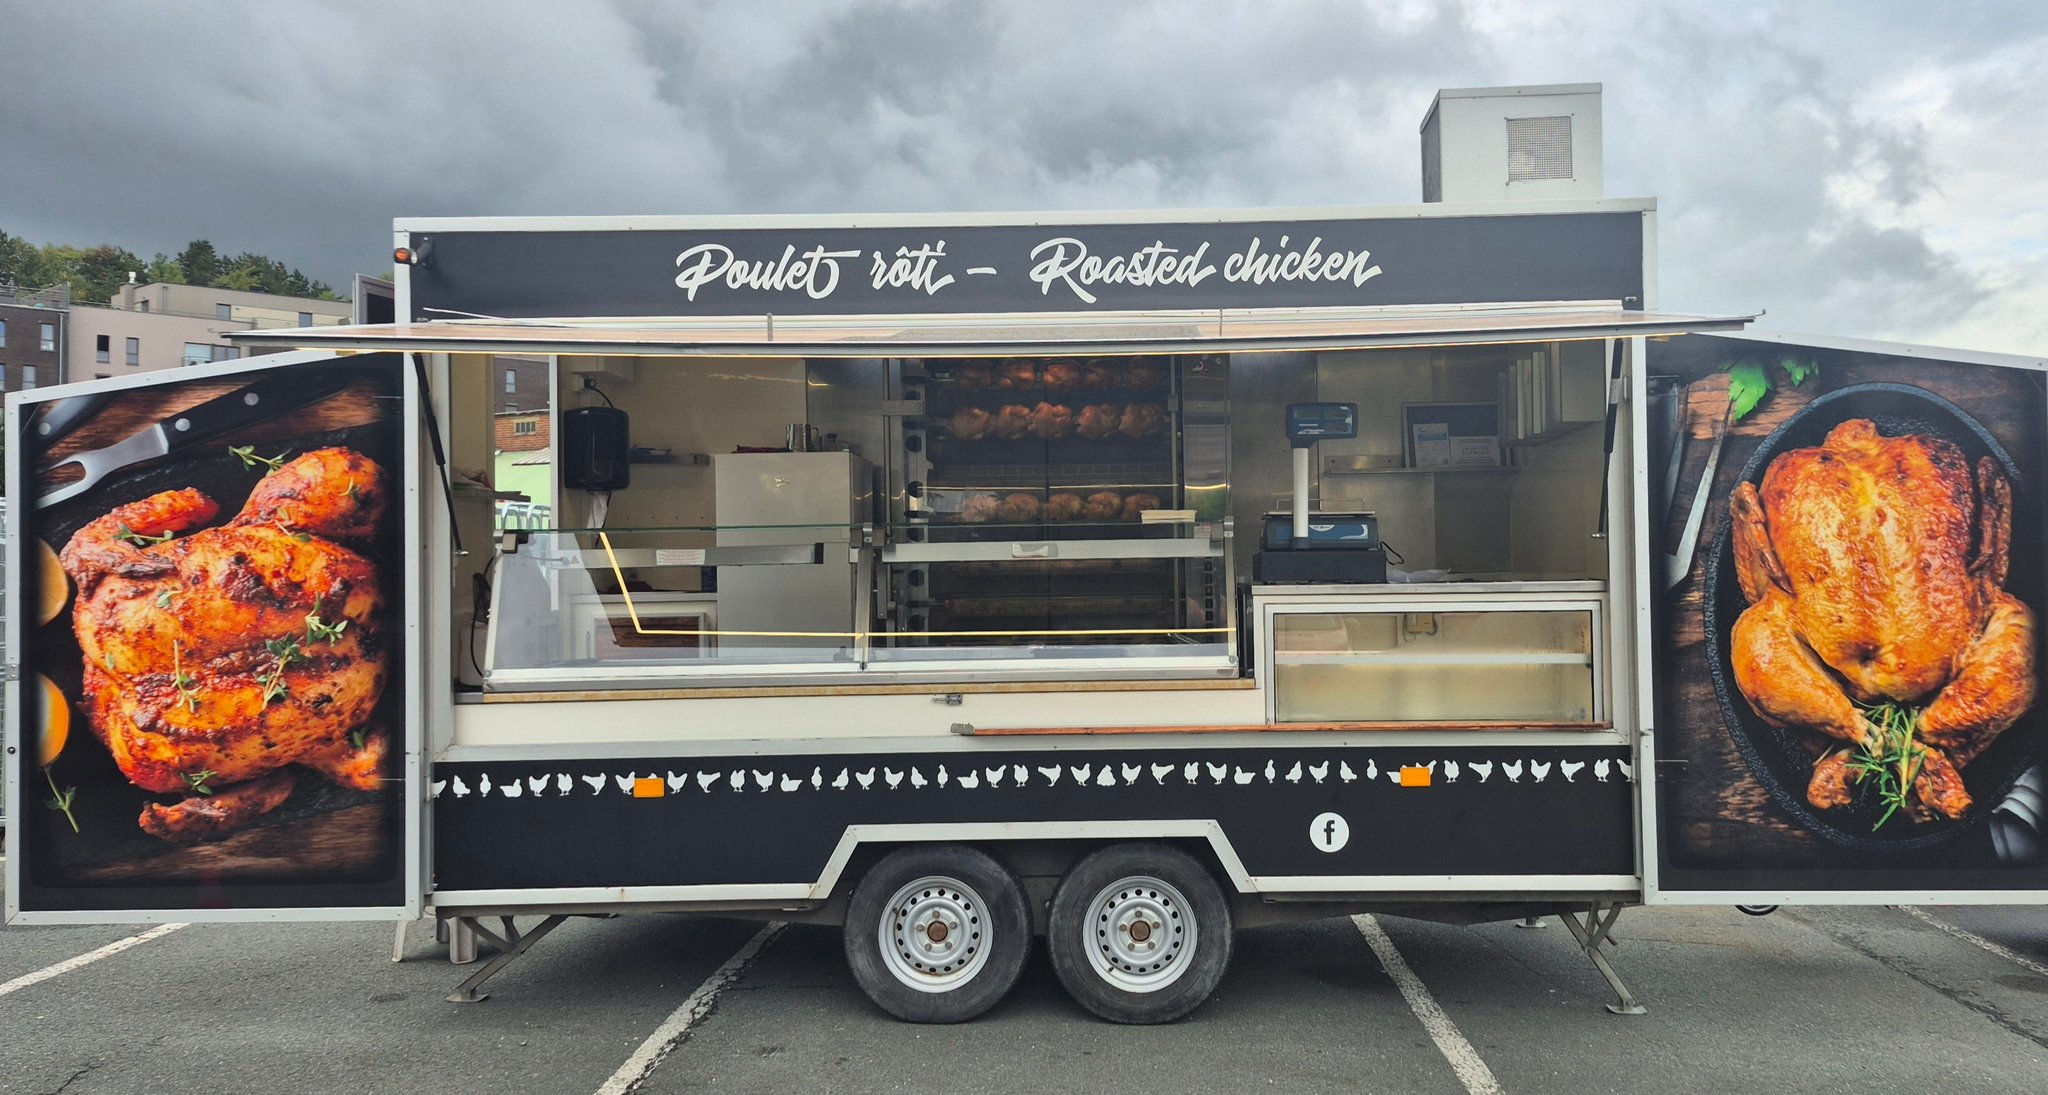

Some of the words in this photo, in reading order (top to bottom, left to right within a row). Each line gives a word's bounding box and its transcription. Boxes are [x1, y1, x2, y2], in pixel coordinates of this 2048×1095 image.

[674, 243, 862, 302] Poulet
[869, 239, 956, 297] rôti
[1029, 238, 1218, 304] Roasted
[1223, 234, 1383, 288] chicken
